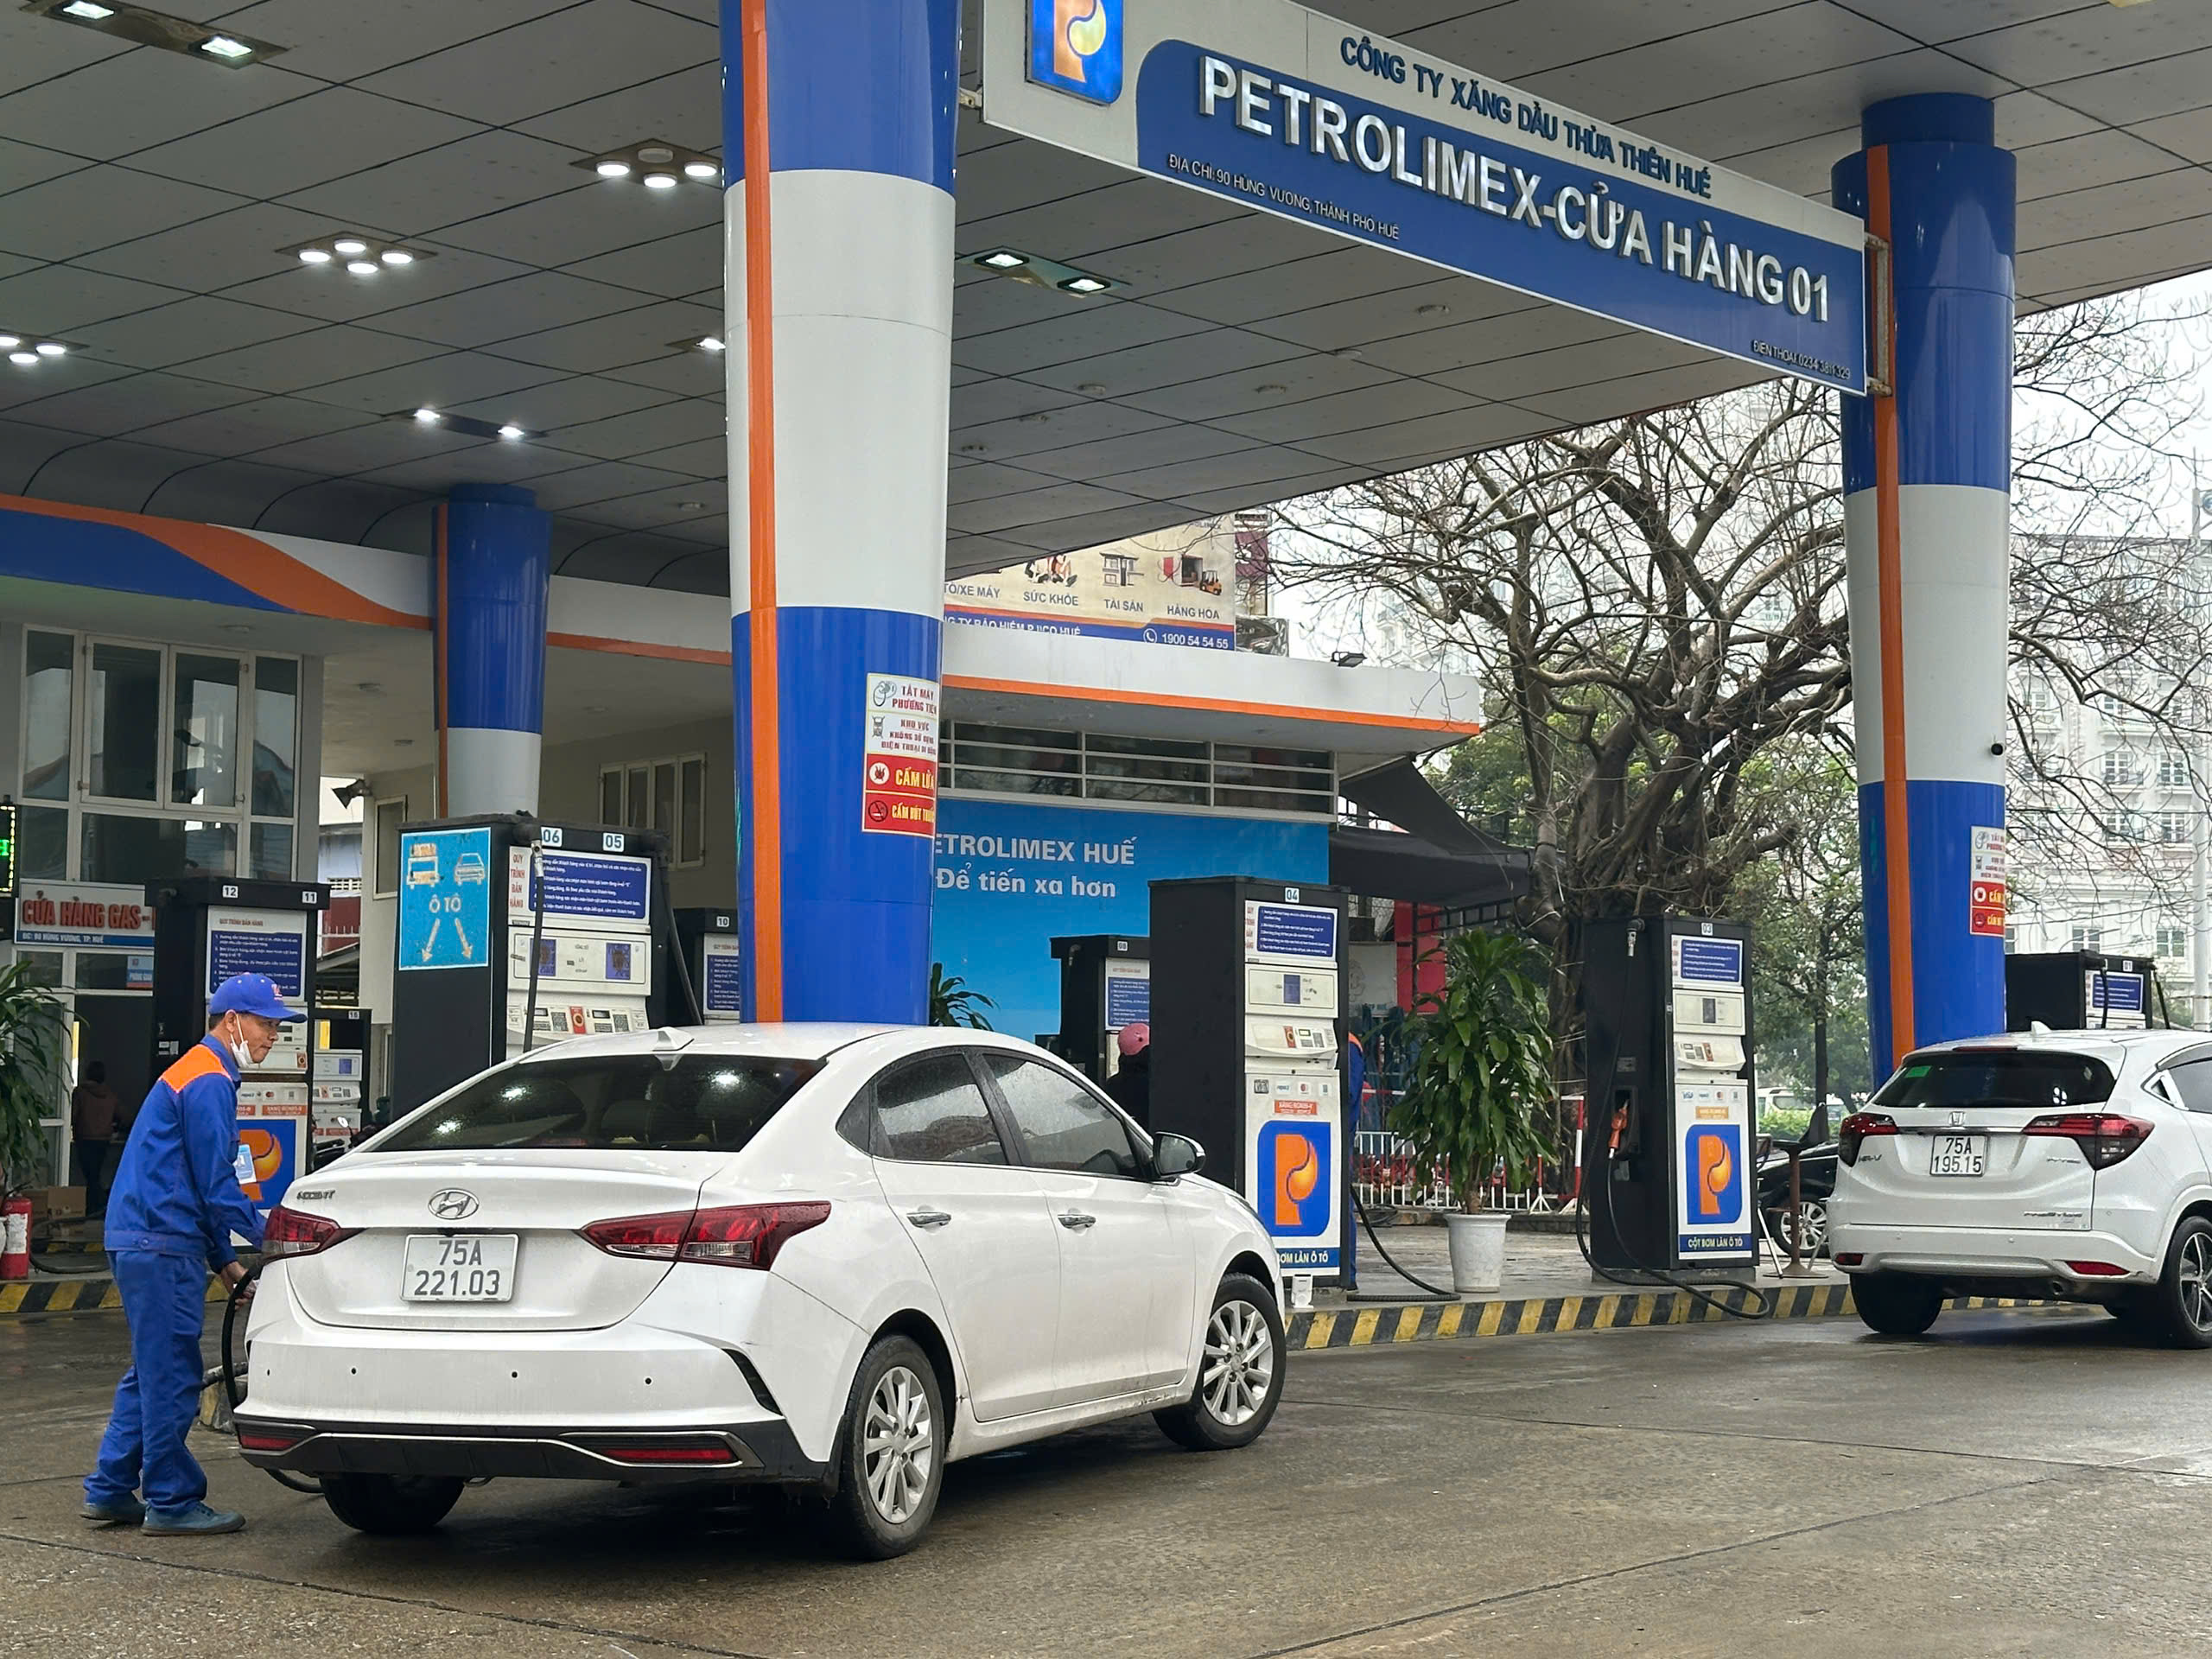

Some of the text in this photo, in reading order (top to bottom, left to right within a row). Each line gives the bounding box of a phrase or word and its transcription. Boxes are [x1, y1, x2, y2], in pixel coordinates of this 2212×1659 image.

[1340, 36, 1406, 84] CÔNG
[1414, 64, 1444, 98] TY
[1451, 77, 1511, 124] XĂNG
[1517, 100, 1558, 140] DẦU
[1619, 141, 1671, 183] THIÊN
[1675, 162, 1712, 200] HUẾ
[1216, 168, 1230, 187] 90
[1662, 220, 1783, 305] HÀNG
[1788, 266, 1828, 322] 01
[977, 585, 1001, 599] MÁY
[1023, 589, 1046, 603] SỨC
[1166, 603, 1196, 618] HÀNG
[1161, 632, 1229, 649] 1900 54 54 55
[895, 766, 920, 788] CẤM
[891, 801, 909, 820] CẤM
[543, 829, 561, 843] 06
[605, 835, 622, 849] 05
[1084, 836, 1138, 865] HUẾ
[935, 861, 1116, 898] Để tiến xa hơn
[225, 887, 237, 897] 12
[304, 893, 315, 903] 11
[1286, 889, 1298, 900] 04
[22, 890, 56, 925] CỬA
[60, 896, 105, 928] HÀNG
[429, 893, 461, 913] Ô TÔ
[718, 918, 728, 926] 10
[1702, 924, 1712, 934] 03
[1945, 1137, 1972, 1154] 75A
[1934, 1155, 1982, 1173] 195.15
[1688, 1236, 1700, 1250] CỘT
[438, 1240, 482, 1266] 75A
[1280, 1252, 1293, 1263] ƠM
[1310, 1249, 1318, 1263] Ô
[1319, 1249, 1328, 1263] TÔ
[414, 1269, 500, 1296] 221.03
